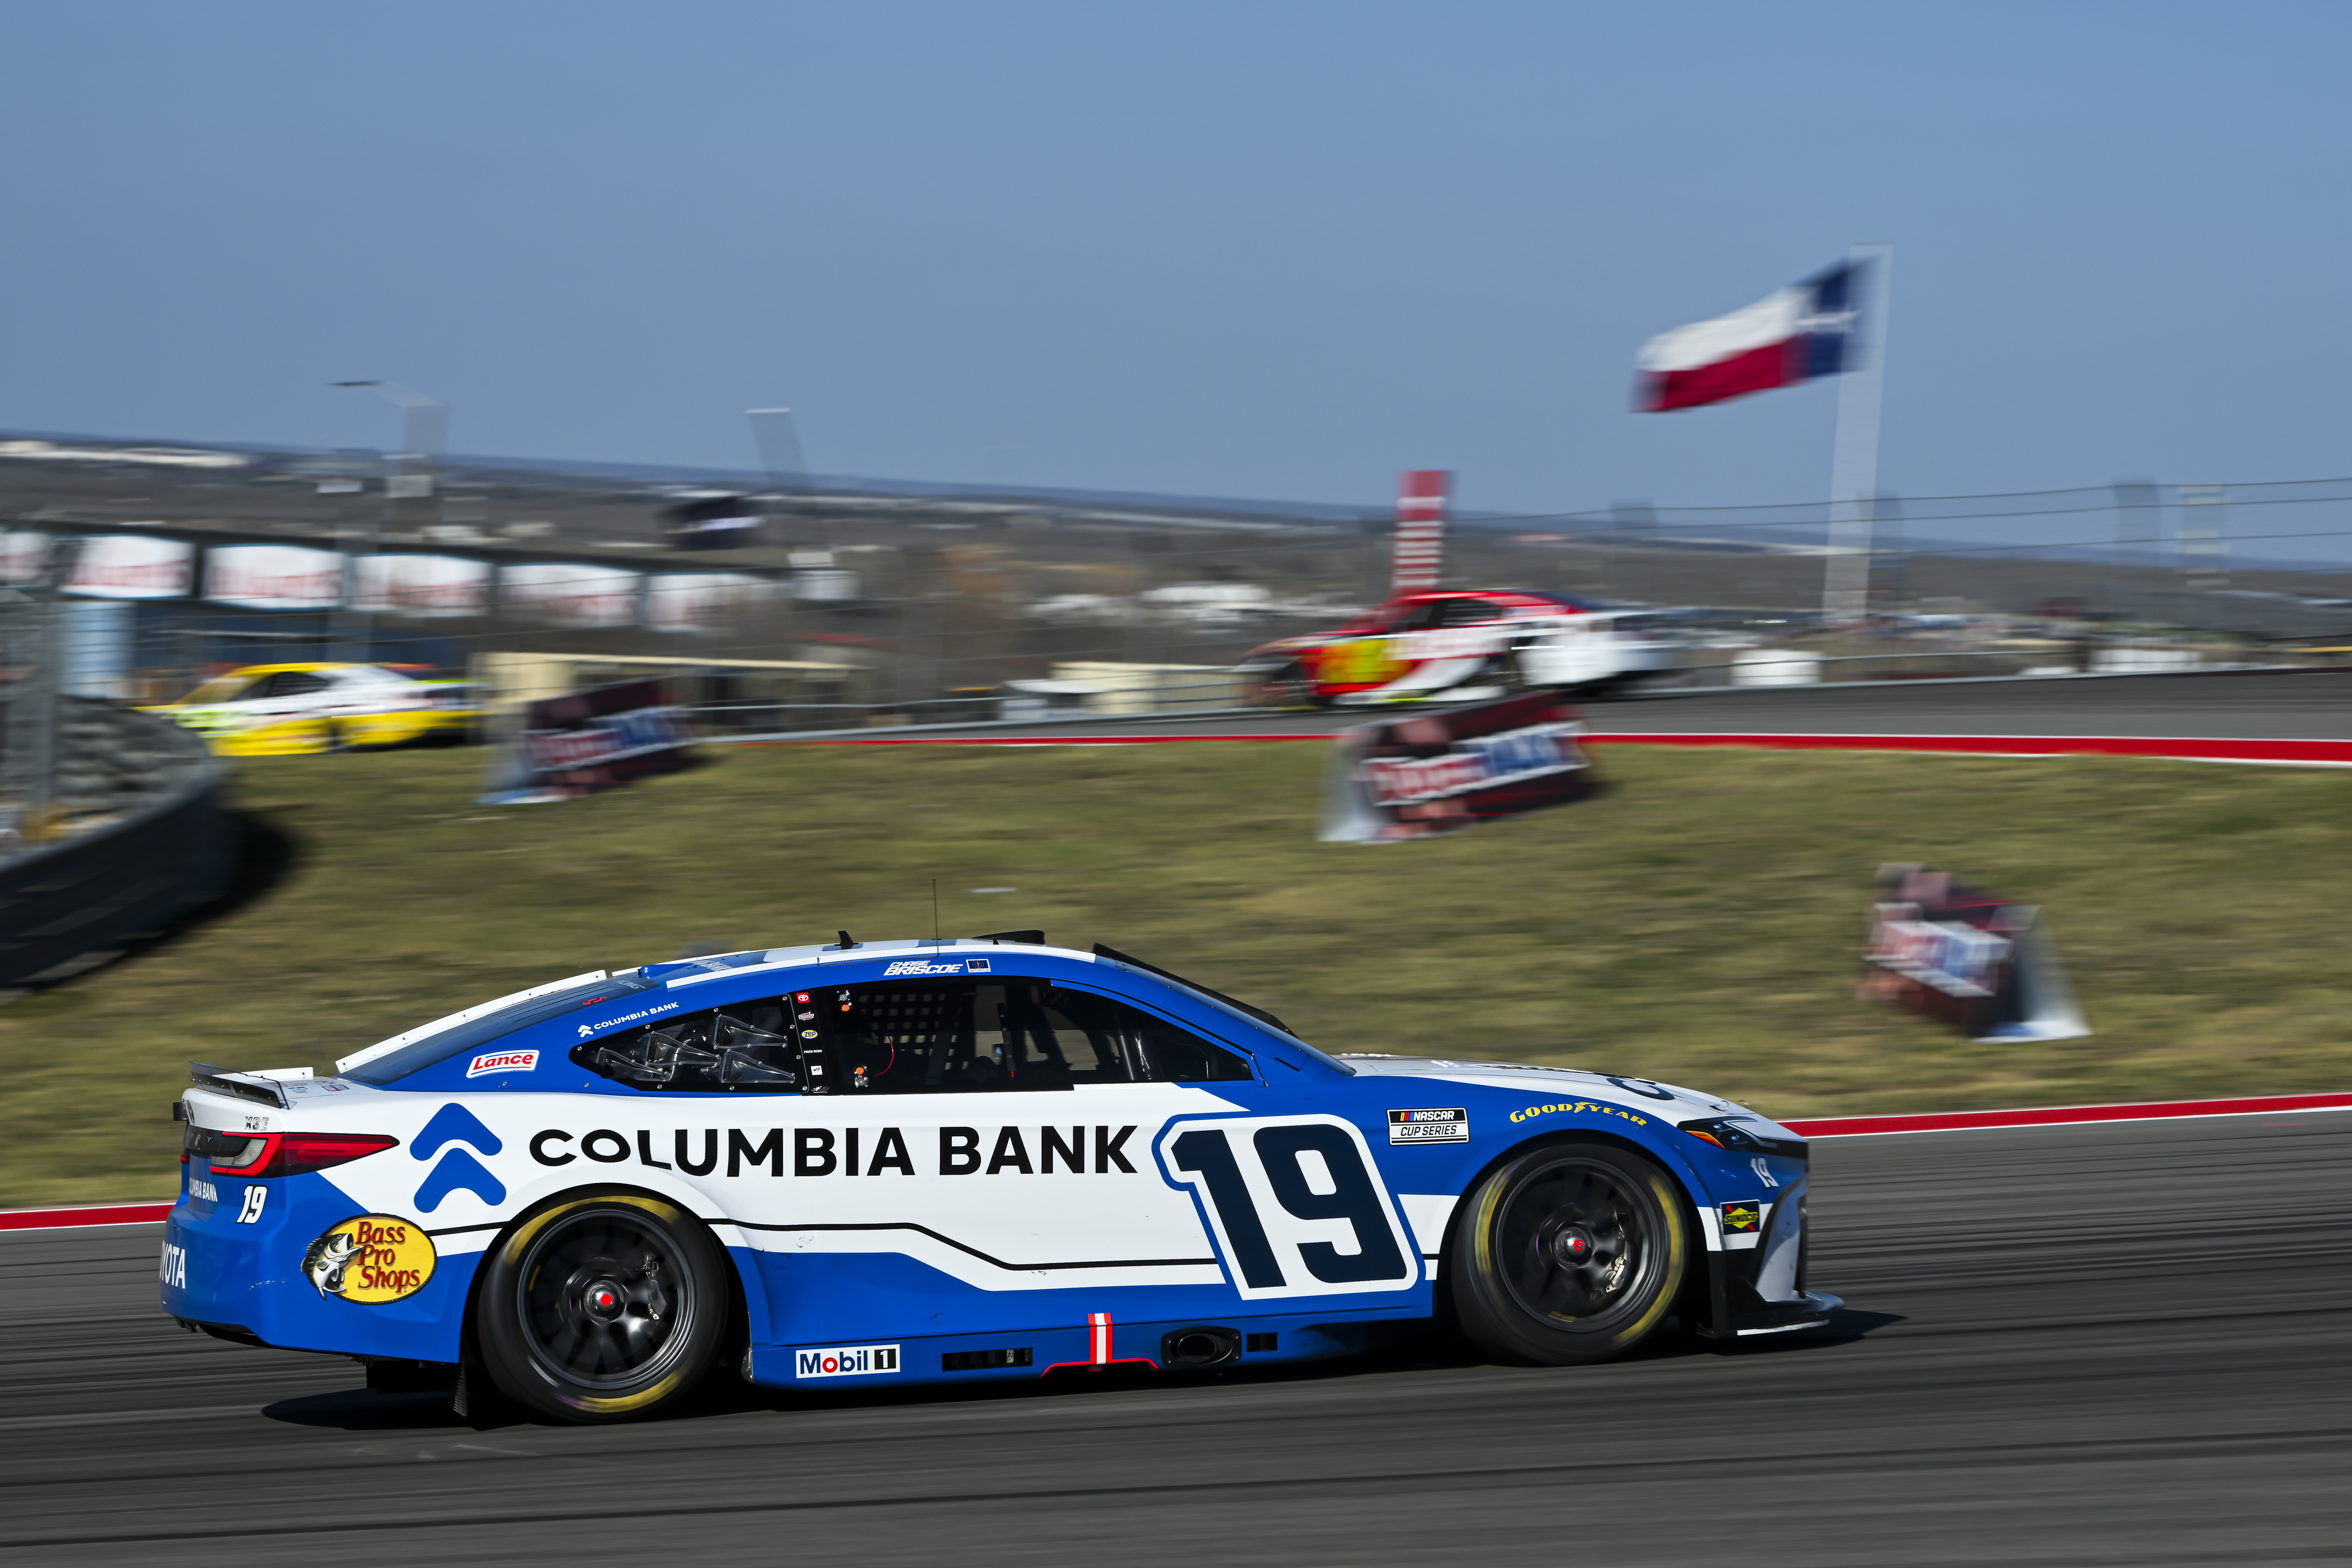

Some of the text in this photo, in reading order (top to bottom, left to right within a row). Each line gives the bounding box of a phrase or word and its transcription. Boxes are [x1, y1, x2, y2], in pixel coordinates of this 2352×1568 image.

[883, 964, 964, 976] BRISCOE
[594, 1001, 680, 1029] COLUMBIA BANK
[473, 1054, 534, 1071] Lance
[244, 1116, 269, 1131] XSE
[1413, 1111, 1455, 1121] NASCAR
[1509, 1102, 1647, 1126] GOODYEAR
[1401, 1125, 1457, 1136] CUP SERIES
[529, 1125, 1138, 1177] COLUMBIA BANK
[1750, 1157, 1780, 1188] 19
[236, 1185, 268, 1224] 19
[1170, 1123, 1408, 1289] 19
[355, 1221, 406, 1245] Bass
[159, 1239, 186, 1289] OYOTA
[357, 1244, 396, 1266] Pro
[358, 1265, 420, 1293] Shops
[800, 1349, 868, 1375] Mobil
